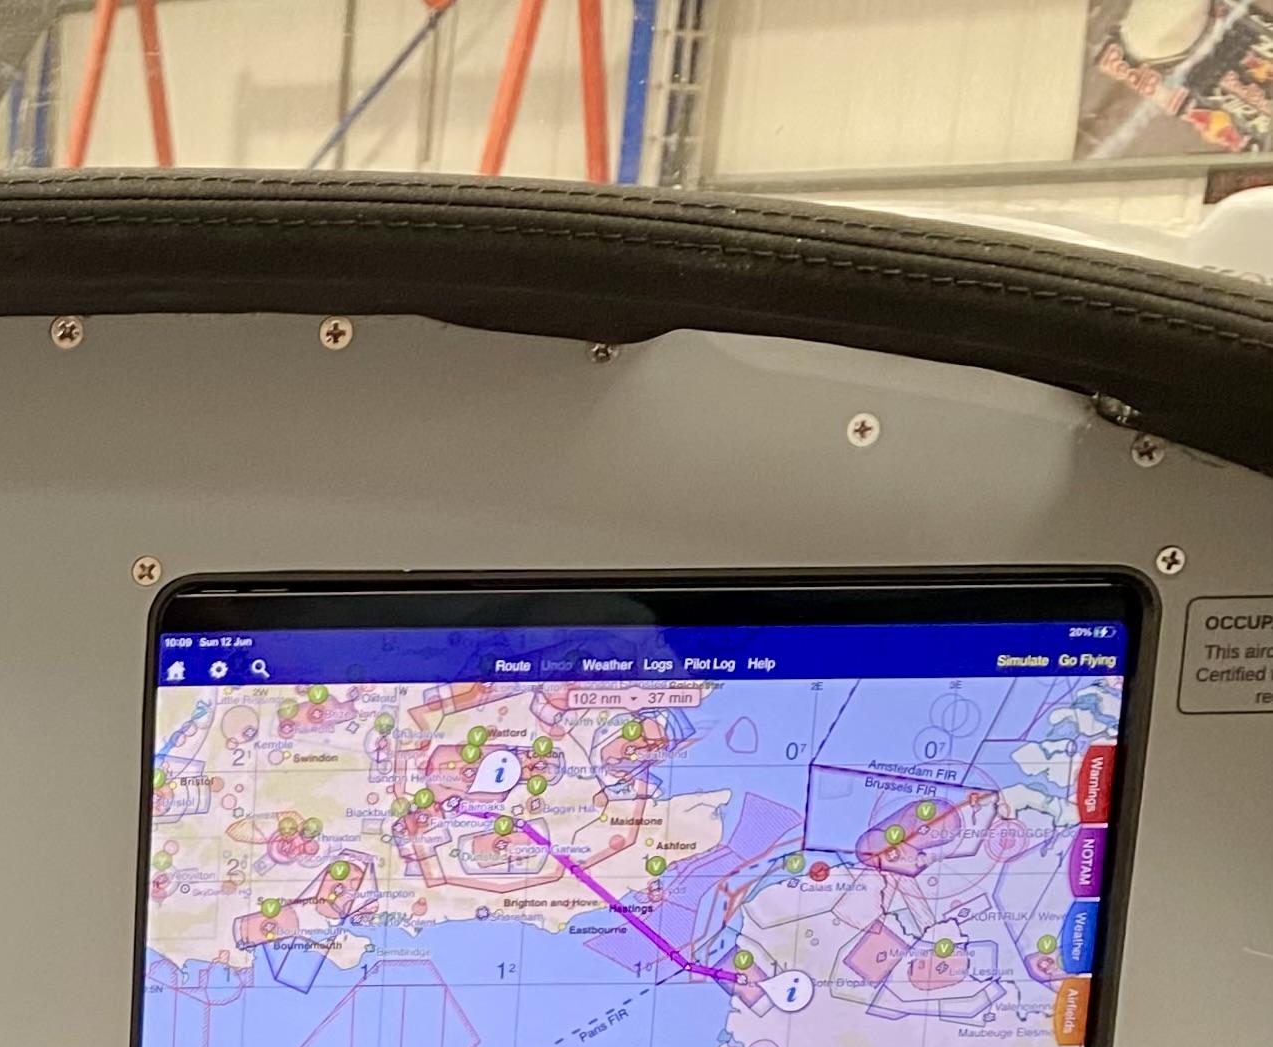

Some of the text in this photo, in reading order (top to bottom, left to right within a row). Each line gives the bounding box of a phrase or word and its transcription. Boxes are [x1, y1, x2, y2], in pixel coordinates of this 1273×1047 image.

[1206, 616, 1273, 630] OCCUP
[165, 638, 192, 648] 10:09
[199, 637, 252, 648] Sun 12 Jun
[1205, 645, 1241, 659] This
[495, 660, 531, 672] Route
[583, 659, 633, 671] Weather
[643, 658, 673, 672] Logs
[684, 658, 735, 672] Pilot Log
[747, 657, 775, 672] Help
[997, 654, 1049, 666] Simulate
[1058, 654, 1116, 668] Go Flying
[1196, 668, 1266, 682] Certified
[573, 692, 692, 705] 102 nm 37 min
[487, 728, 527, 737] Watford
[293, 753, 338, 763] Swindon
[868, 760, 957, 781] Amsterdam FIR
[1084, 756, 1104, 812] Warnings
[610, 816, 663, 826] Maidstone
[656, 840, 697, 850] Ashford
[1079, 838, 1096, 887] NOTAM
[609, 904, 653, 914] Hastings
[569, 925, 627, 935] Eastbourne
[1071, 912, 1087, 961] Weather
[1062, 988, 1079, 1035] Airfields
